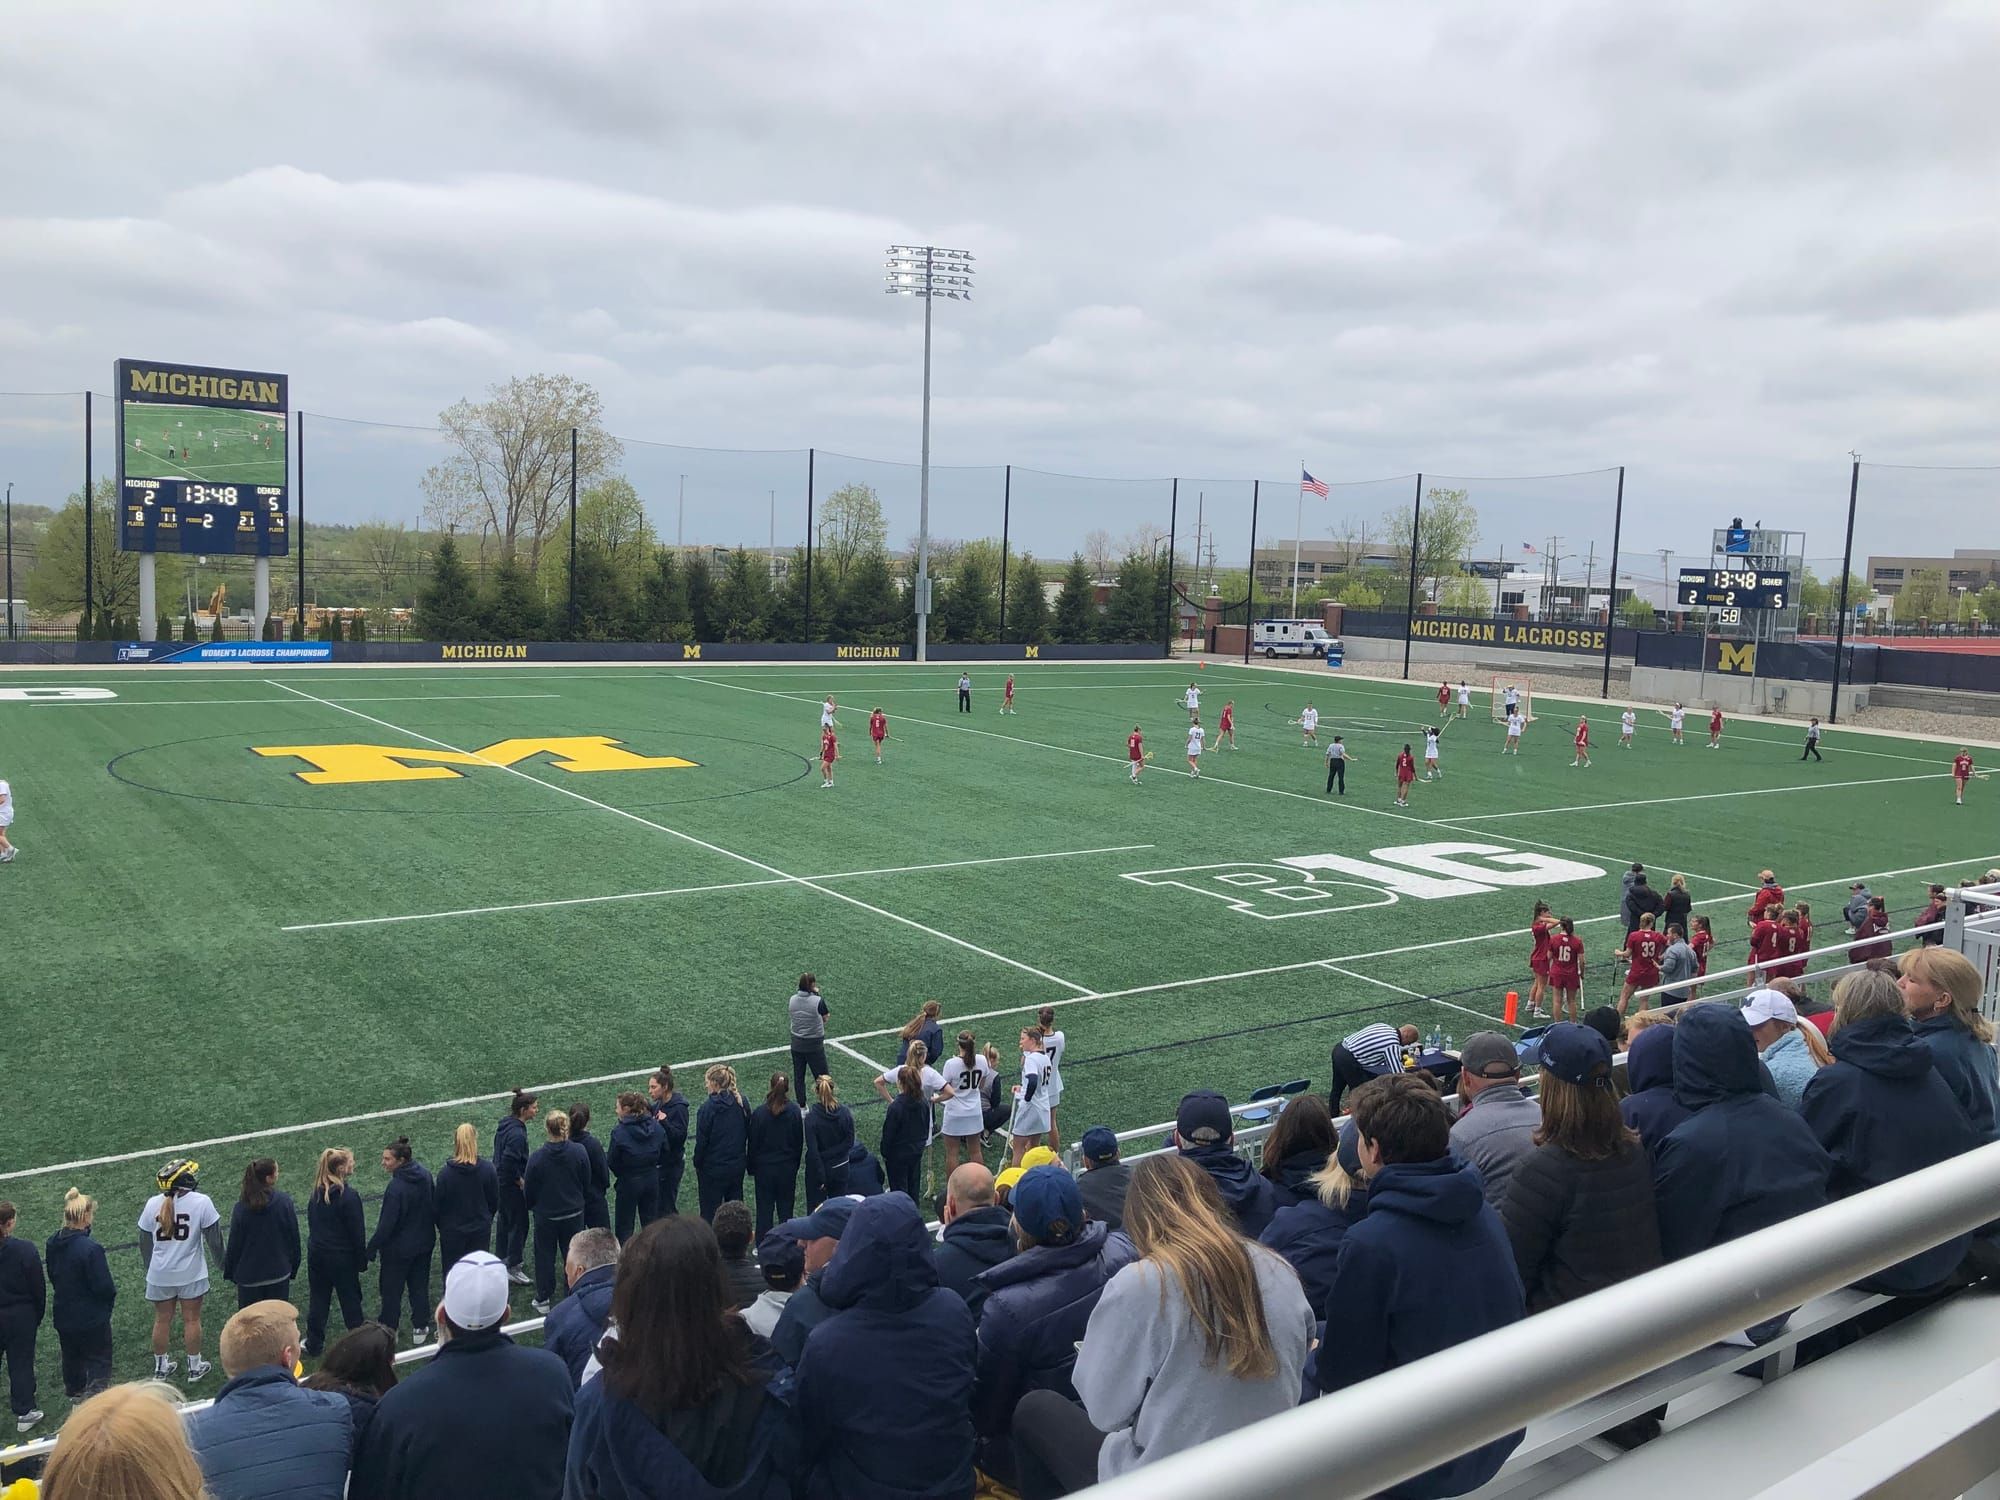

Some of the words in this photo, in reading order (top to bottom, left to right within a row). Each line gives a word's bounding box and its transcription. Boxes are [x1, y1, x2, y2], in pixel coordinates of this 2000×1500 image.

[130, 370, 278, 404] MICHIGAN
[126, 480, 160, 488] MICHIGAN
[257, 486, 281, 496] DENVER
[144, 490, 155, 505] 2
[186, 485, 238, 506] 13:48
[268, 496, 279, 511] 5
[136, 511, 144, 521] 8
[164, 513, 176, 522] 11
[202, 513, 214, 528] 2
[239, 516, 254, 526] 21
[276, 519, 284, 527] 4
[1714, 571, 1756, 590] 13:48
[1689, 590, 1697, 604] 2
[1726, 592, 1735, 605] 2
[1774, 594, 1782, 608] 5
[1722, 609, 1738, 623] 58
[1410, 620, 1495, 641] MICHIGAN
[1504, 626, 1606, 648] LACROSSE
[201, 649, 236, 657] WOMEN'S
[238, 649, 275, 657] LACROSSE
[276, 649, 329, 657] CHAMPIONSHIP
[442, 645, 527, 658] MICHIGAN
[684, 645, 701, 658] M
[837, 646, 900, 658] MICHIGAN
[1025, 646, 1039, 658] M
[1718, 642, 1755, 672] M
[248, 736, 704, 784] M
[1771, 932, 1777, 947] 4
[1788, 937, 1796, 952] 8
[1558, 946, 1570, 961] 16
[1641, 941, 1656, 958] 33
[960, 1069, 982, 1090] 30
